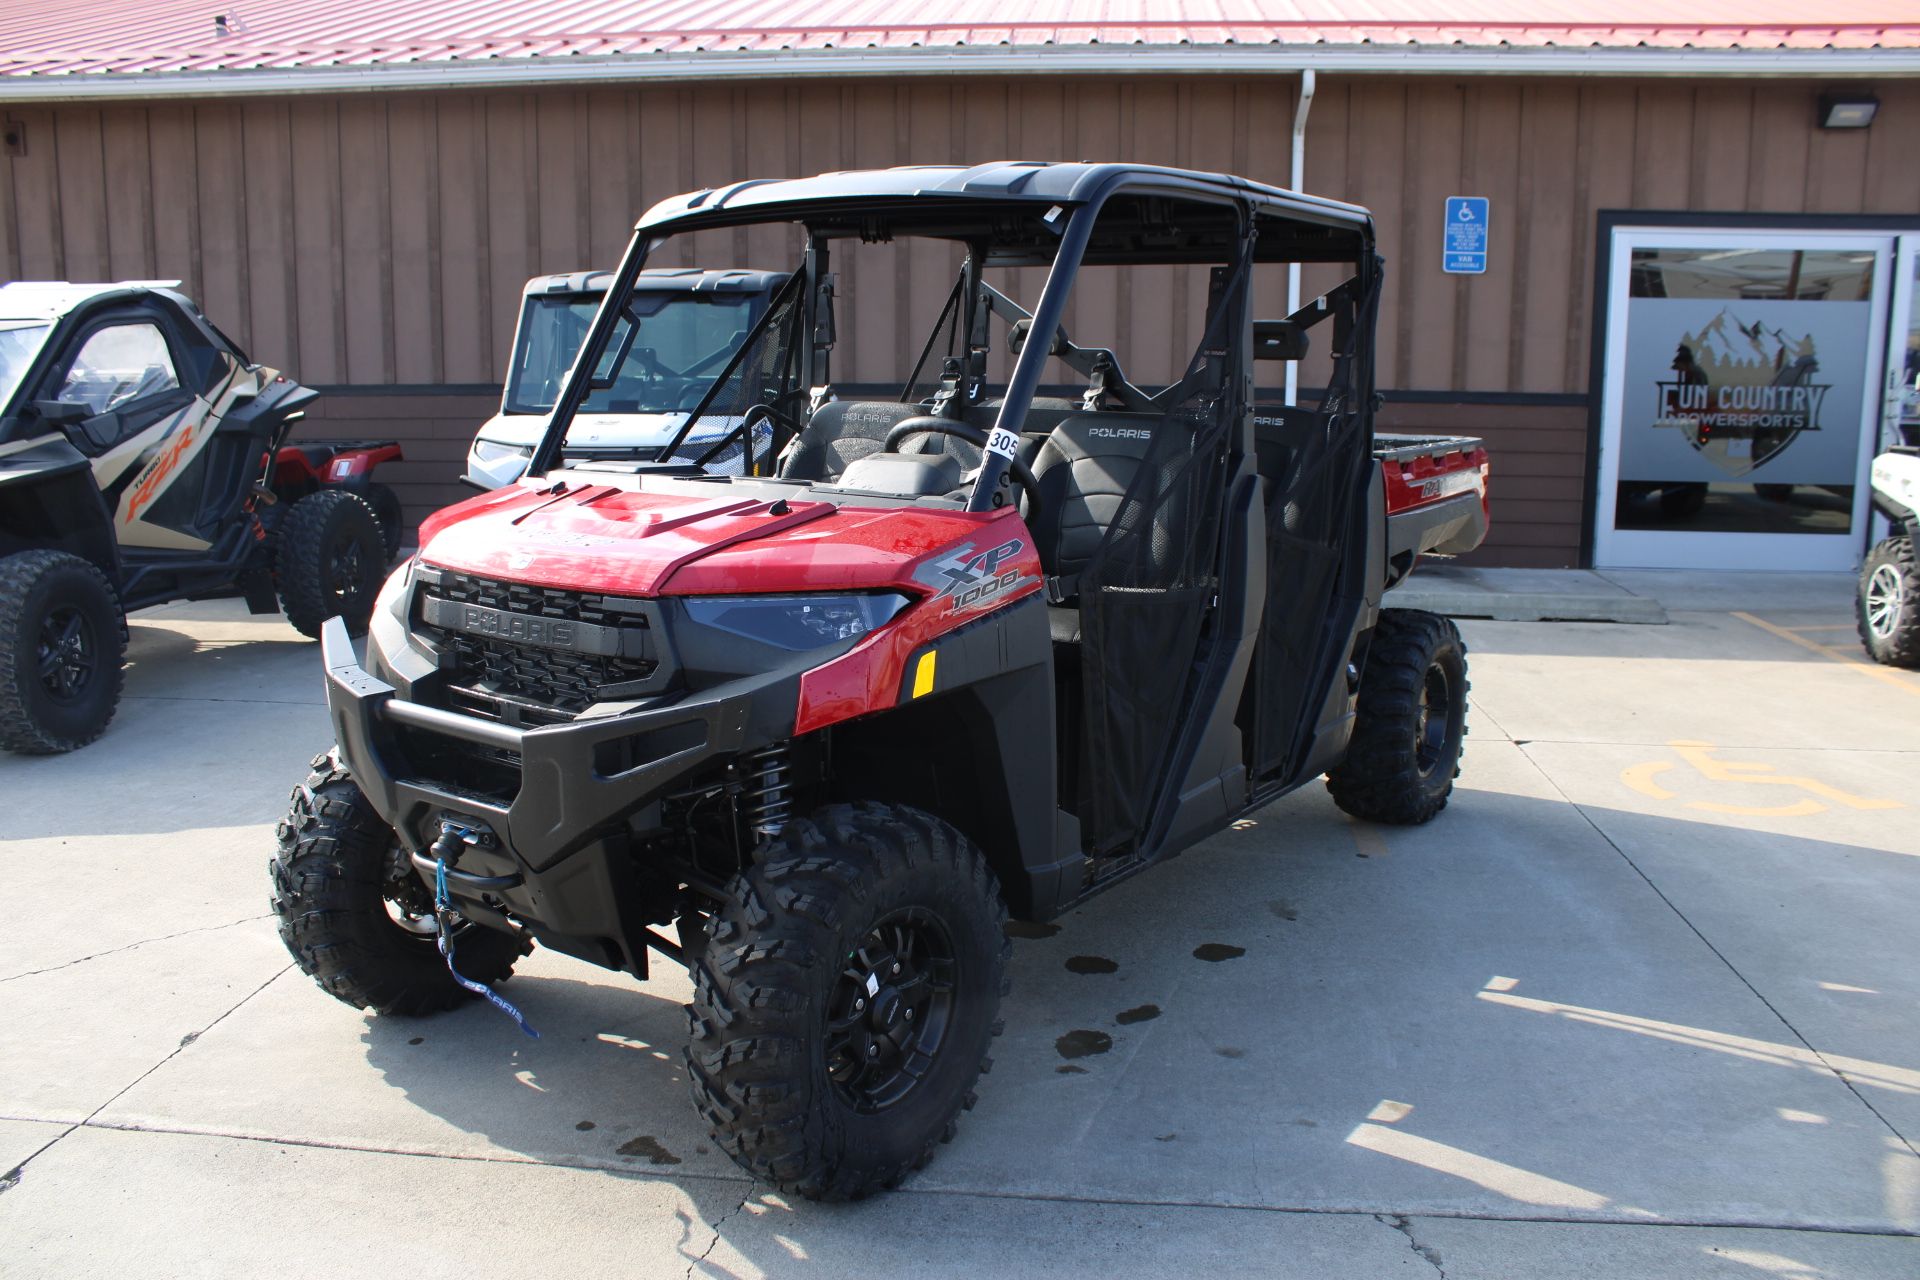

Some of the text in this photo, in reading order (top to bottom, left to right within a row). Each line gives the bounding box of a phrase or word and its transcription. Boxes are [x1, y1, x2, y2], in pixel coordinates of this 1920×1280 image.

[841, 412, 892, 423] POLARIS
[1252, 415, 1284, 426] ARIS
[1656, 383, 1825, 429] FUN COUNTRY
[1676, 411, 1805, 429] POWERSPORTS
[990, 432, 1018, 456] 305
[1088, 428, 1151, 439] POLARIS
[125, 424, 194, 526] RZR
[927, 538, 1025, 604] XP
[952, 567, 1020, 613] 1000
[465, 608, 576, 646] POLARIS
[464, 980, 523, 1024] POLARIS
